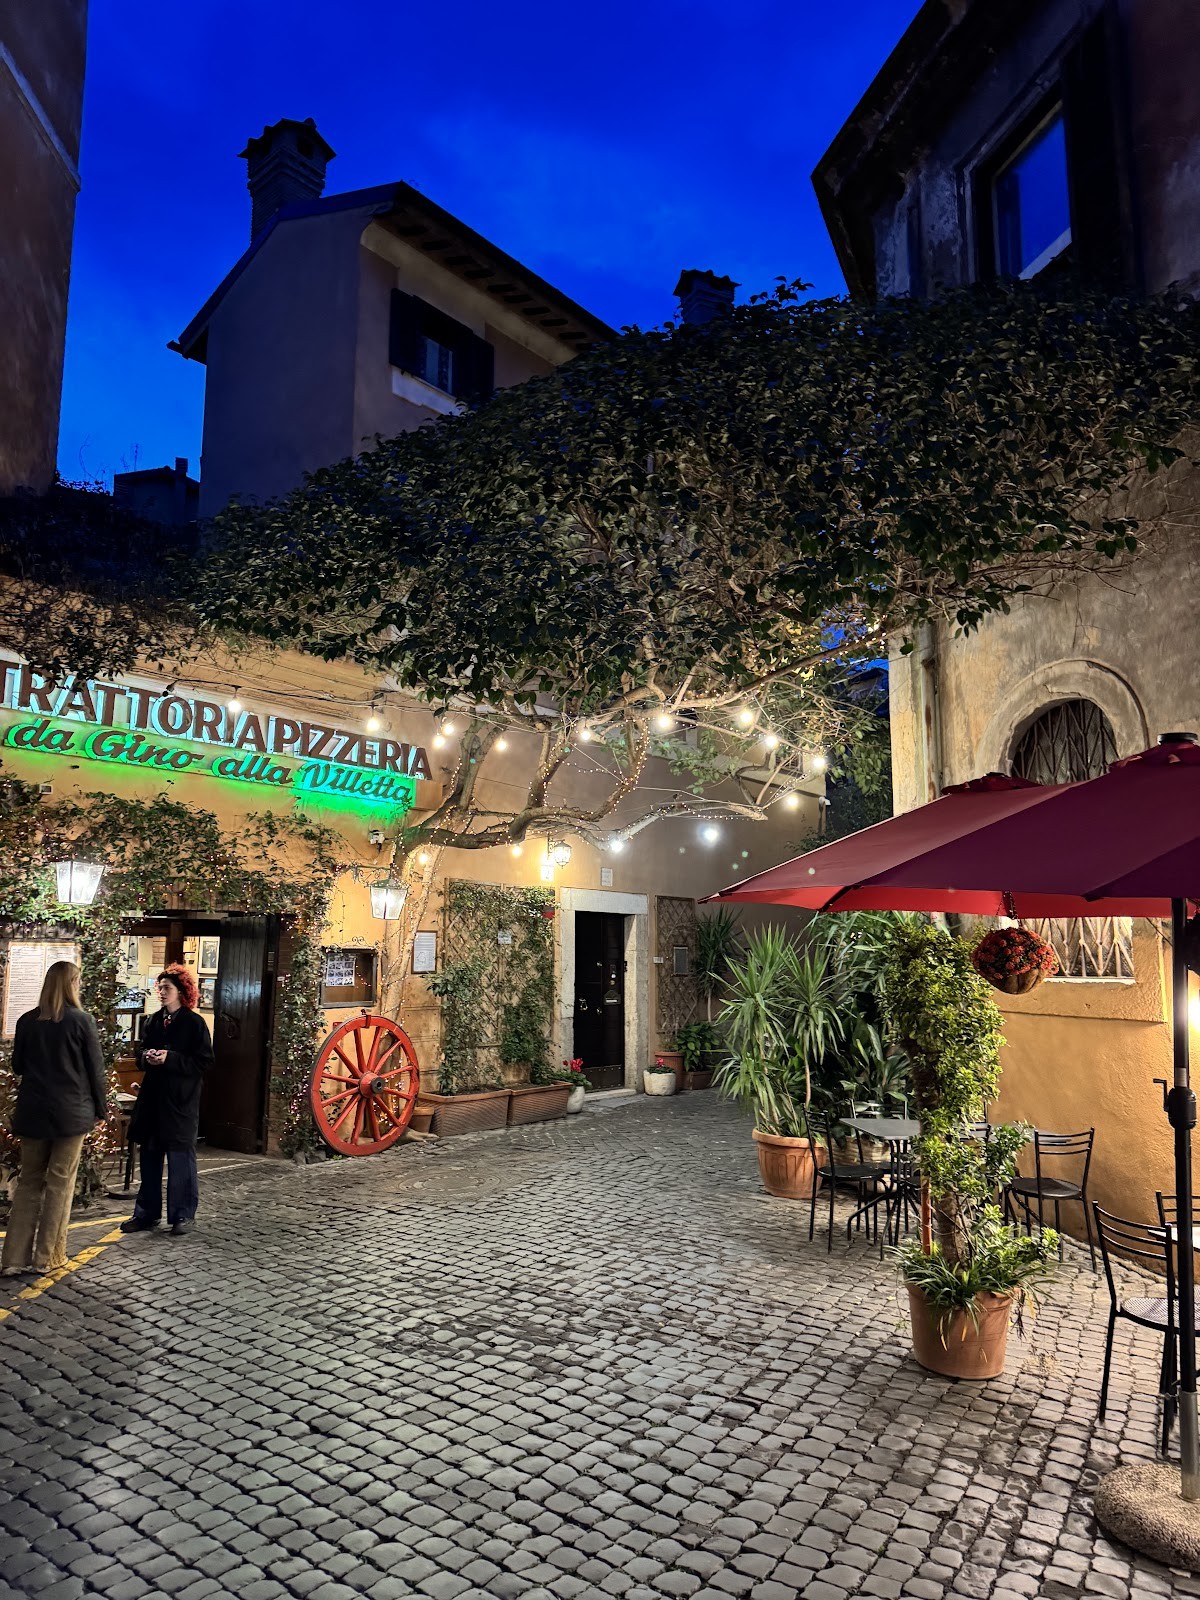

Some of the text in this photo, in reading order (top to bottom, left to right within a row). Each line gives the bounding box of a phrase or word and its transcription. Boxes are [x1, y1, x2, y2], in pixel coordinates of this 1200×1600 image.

[14, 719, 413, 801] da Gino alla Villetta
[273, 717, 433, 781] PIZZERIA
